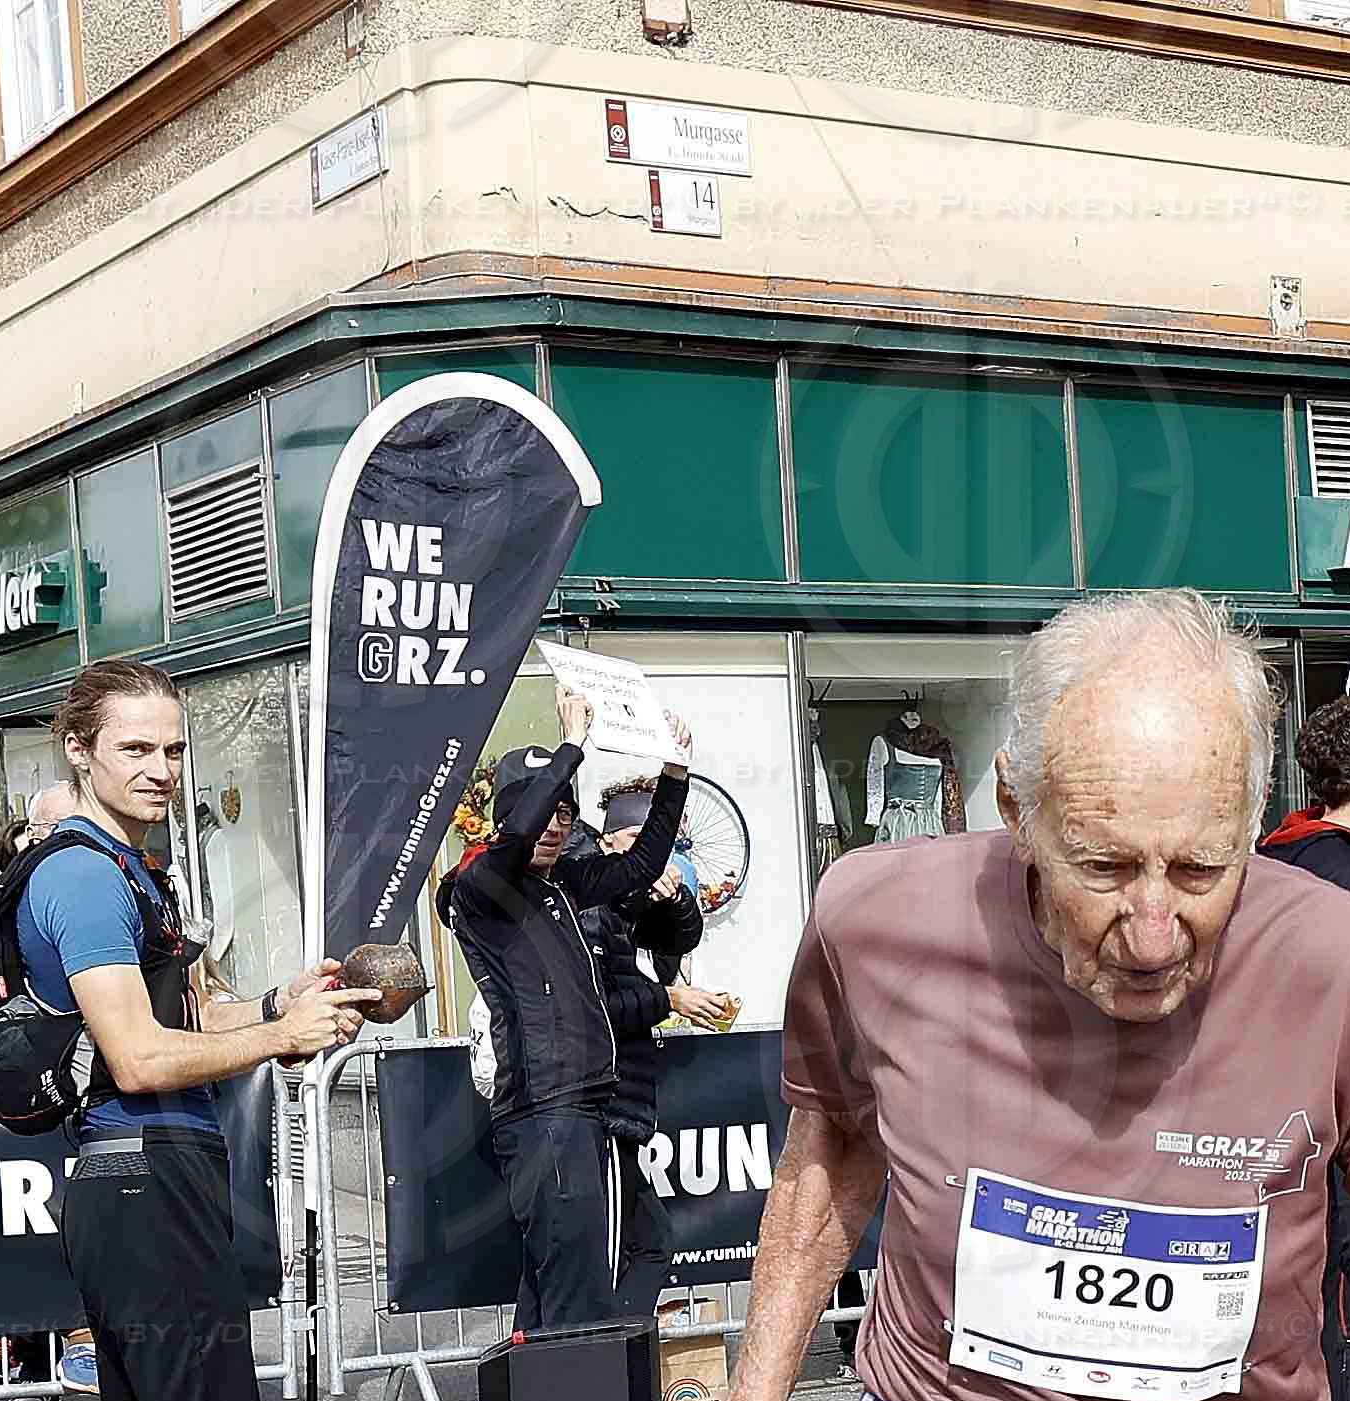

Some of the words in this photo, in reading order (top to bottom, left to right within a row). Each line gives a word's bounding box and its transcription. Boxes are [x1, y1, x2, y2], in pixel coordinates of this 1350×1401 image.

[674, 116, 743, 146] Murgasse
[692, 181, 715, 210] 14
[361, 519, 443, 576] WE
[360, 576, 474, 630] RUN
[358, 632, 487, 686] GRZ.
[369, 737, 462, 929] www.runninGraz.at
[638, 1123, 773, 1198] RUN
[1196, 1136, 1267, 1157] GRAZ
[1179, 1155, 1243, 1170] MARATHON
[1031, 1205, 1079, 1227] GRAZ
[1026, 1221, 1125, 1248] MARATHON
[1044, 1260, 1174, 1312] 1820
[1119, 1321, 1172, 1336] Marathon
